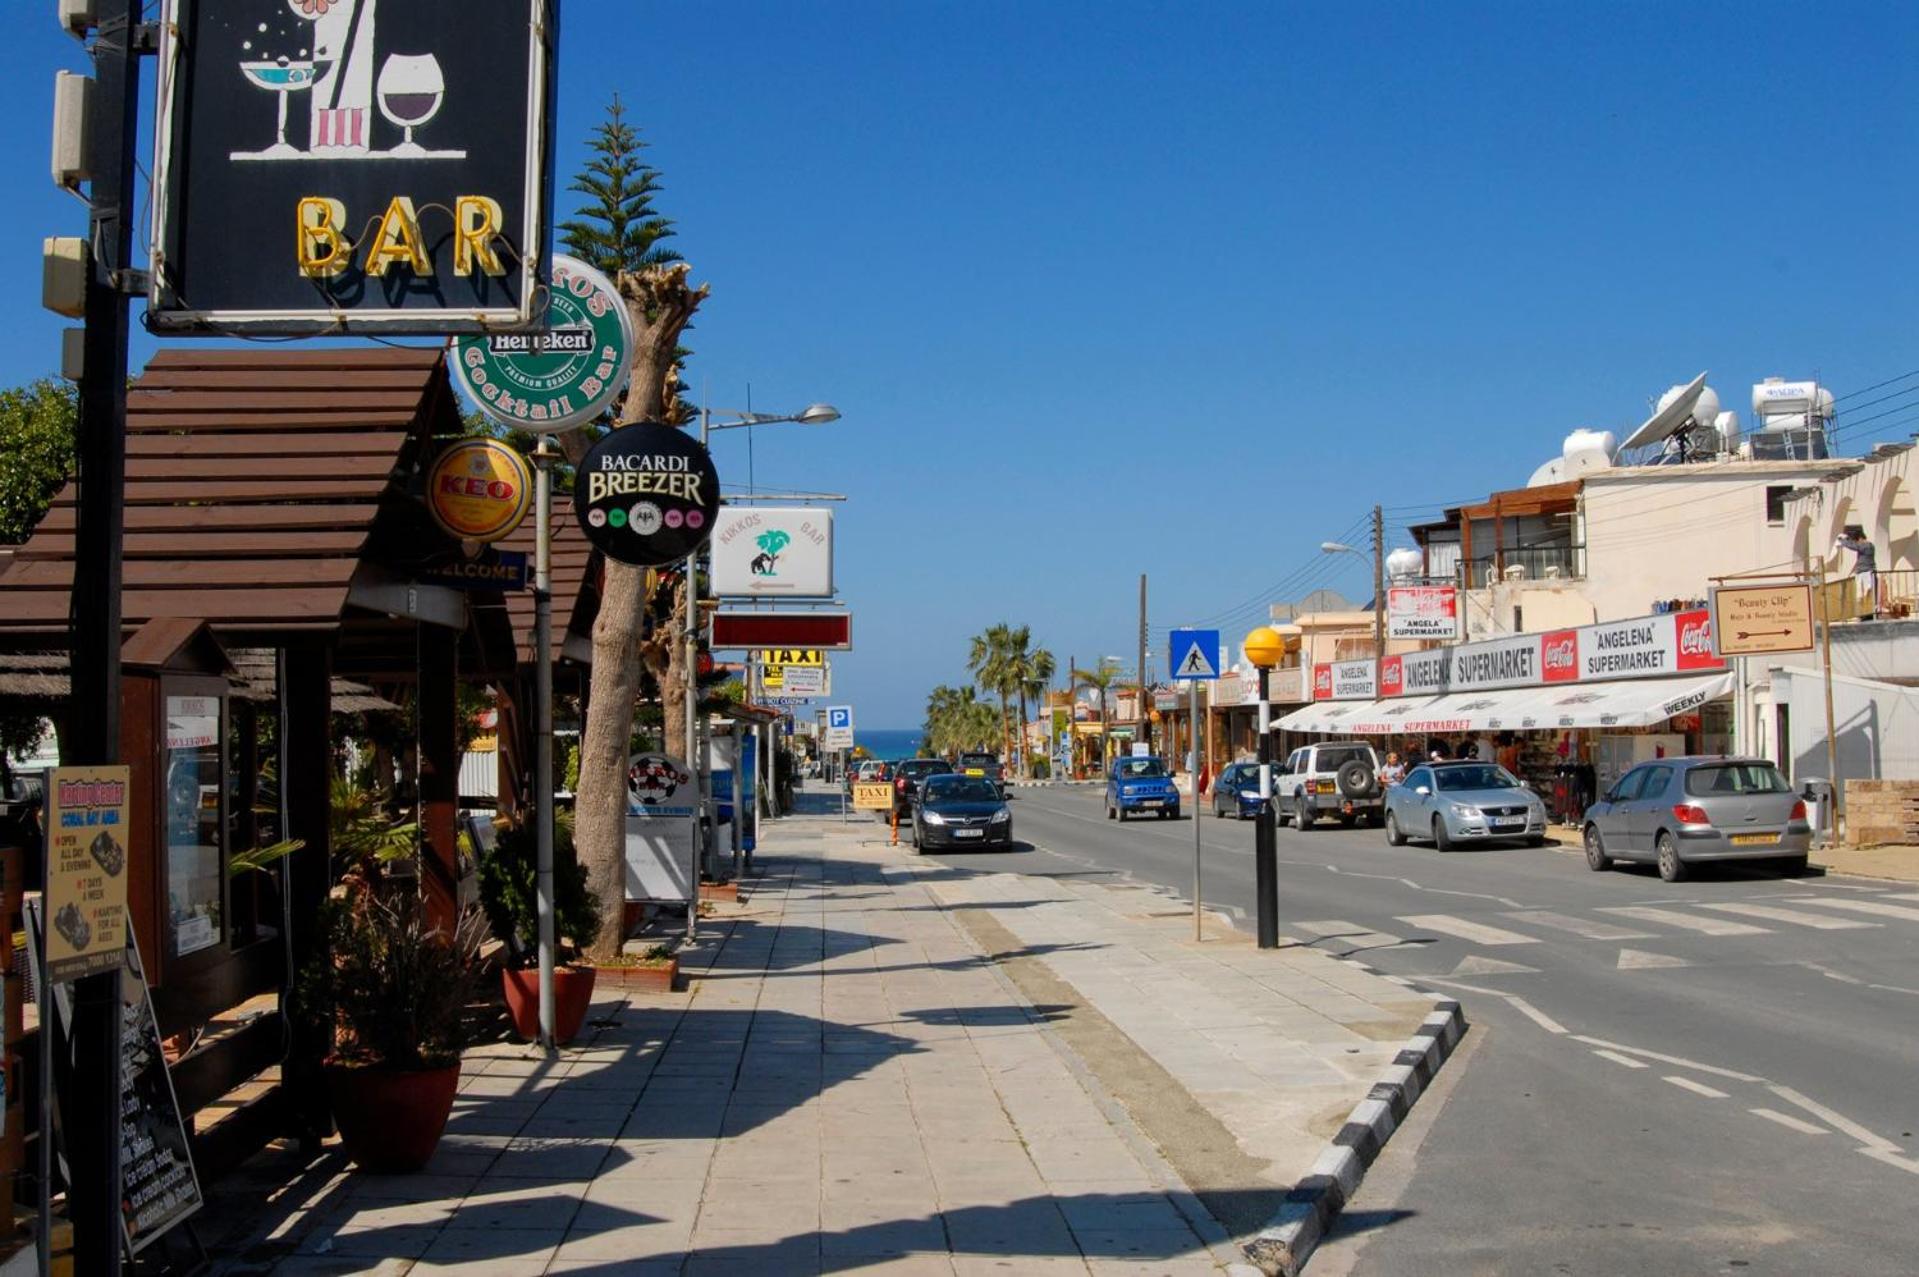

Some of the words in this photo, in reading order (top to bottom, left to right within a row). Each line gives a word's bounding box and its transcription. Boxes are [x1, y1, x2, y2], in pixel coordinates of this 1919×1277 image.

[297, 195, 507, 278] BAR
[464, 346, 573, 420] Cocktail
[578, 345, 617, 400] Bar
[505, 365, 542, 387] PREMIUM
[546, 365, 578, 387] QUALITY
[601, 455, 690, 471] BACARDI
[440, 475, 515, 501] KEO
[588, 472, 705, 506] BREEZER
[800, 521, 825, 545] BAR
[1393, 627, 1453, 636] SUPERMARKET
[767, 648, 821, 663] TAXI
[1458, 647, 1535, 683] SUPERMARKET
[1588, 650, 1665, 673] SUPERMARKET
[1664, 691, 1706, 715] WEEKLY
[834, 711, 847, 726] P
[1403, 719, 1472, 732] SUPERMARKET
[857, 787, 888, 797] TAXI
